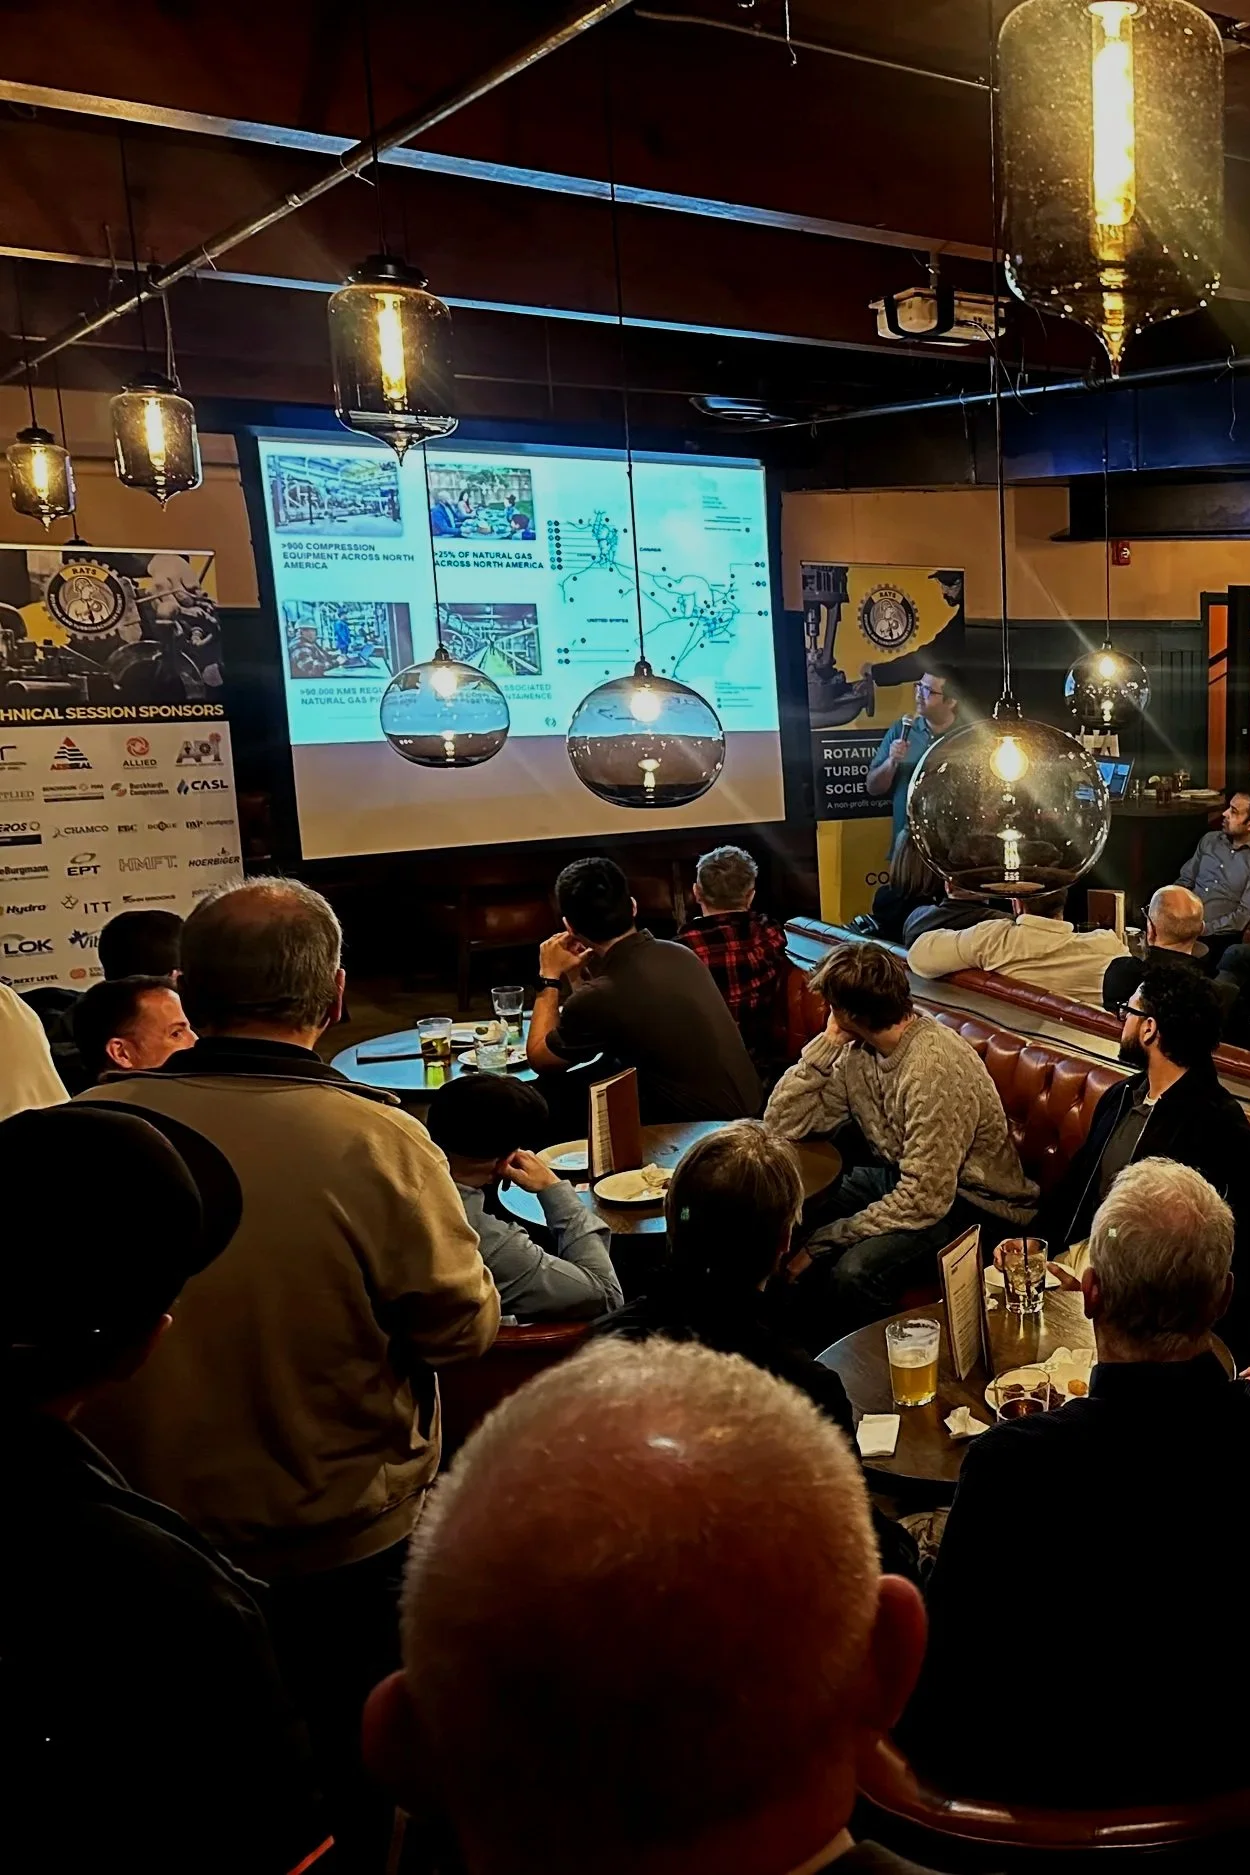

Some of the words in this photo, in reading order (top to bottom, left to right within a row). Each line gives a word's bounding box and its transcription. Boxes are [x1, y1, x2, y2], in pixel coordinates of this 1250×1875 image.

[305, 543, 375, 551] COMPRESSION
[283, 552, 339, 560] EQUIPMENT
[341, 553, 380, 561] ACROSS
[472, 552, 513, 560] NATURAL
[283, 561, 329, 569] AMERICA
[72, 567, 97, 575] RATS
[300, 697, 346, 705] NATURAL
[347, 696, 368, 704] GAS
[0, 708, 64, 721] HNICAL
[65, 706, 137, 719] SESSION
[138, 704, 224, 718] SPONSORS
[823, 747, 879, 760] ROTATIN
[122, 759, 157, 767] ALLIED
[824, 765, 869, 777] TURBO
[191, 779, 229, 790] CASL
[825, 782, 869, 794] SOCIE
[0, 822, 27, 832] EROS
[64, 825, 109, 834] CHAMCO
[188, 855, 241, 868] HOERBIGER
[0, 865, 49, 876] eBurgmann
[67, 865, 101, 876] EPT
[865, 871, 890, 886] CO
[6, 904, 47, 915] Hydro
[84, 901, 112, 914] ITT
[13, 976, 35, 984] NEXT
[36, 974, 59, 983] LEVEL
